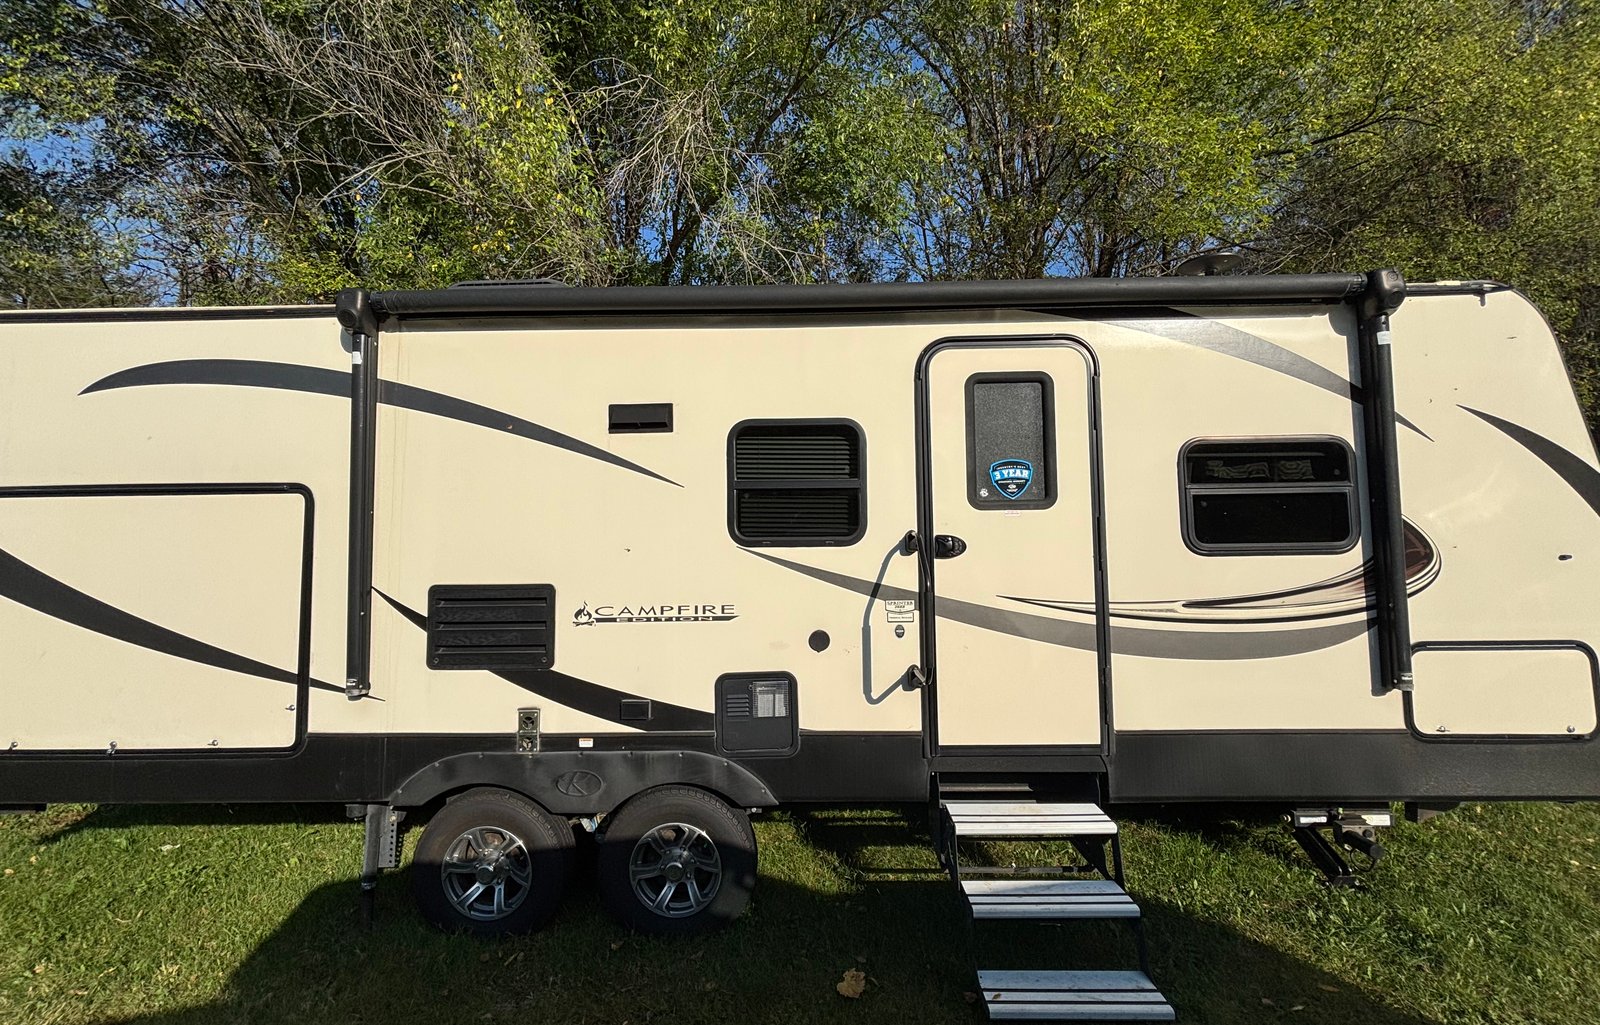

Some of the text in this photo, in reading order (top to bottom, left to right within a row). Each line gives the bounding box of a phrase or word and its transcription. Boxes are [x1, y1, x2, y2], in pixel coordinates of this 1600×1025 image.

[994, 469, 1029, 480] 3 YEAR
[595, 604, 735, 616] CAMPFIRE
